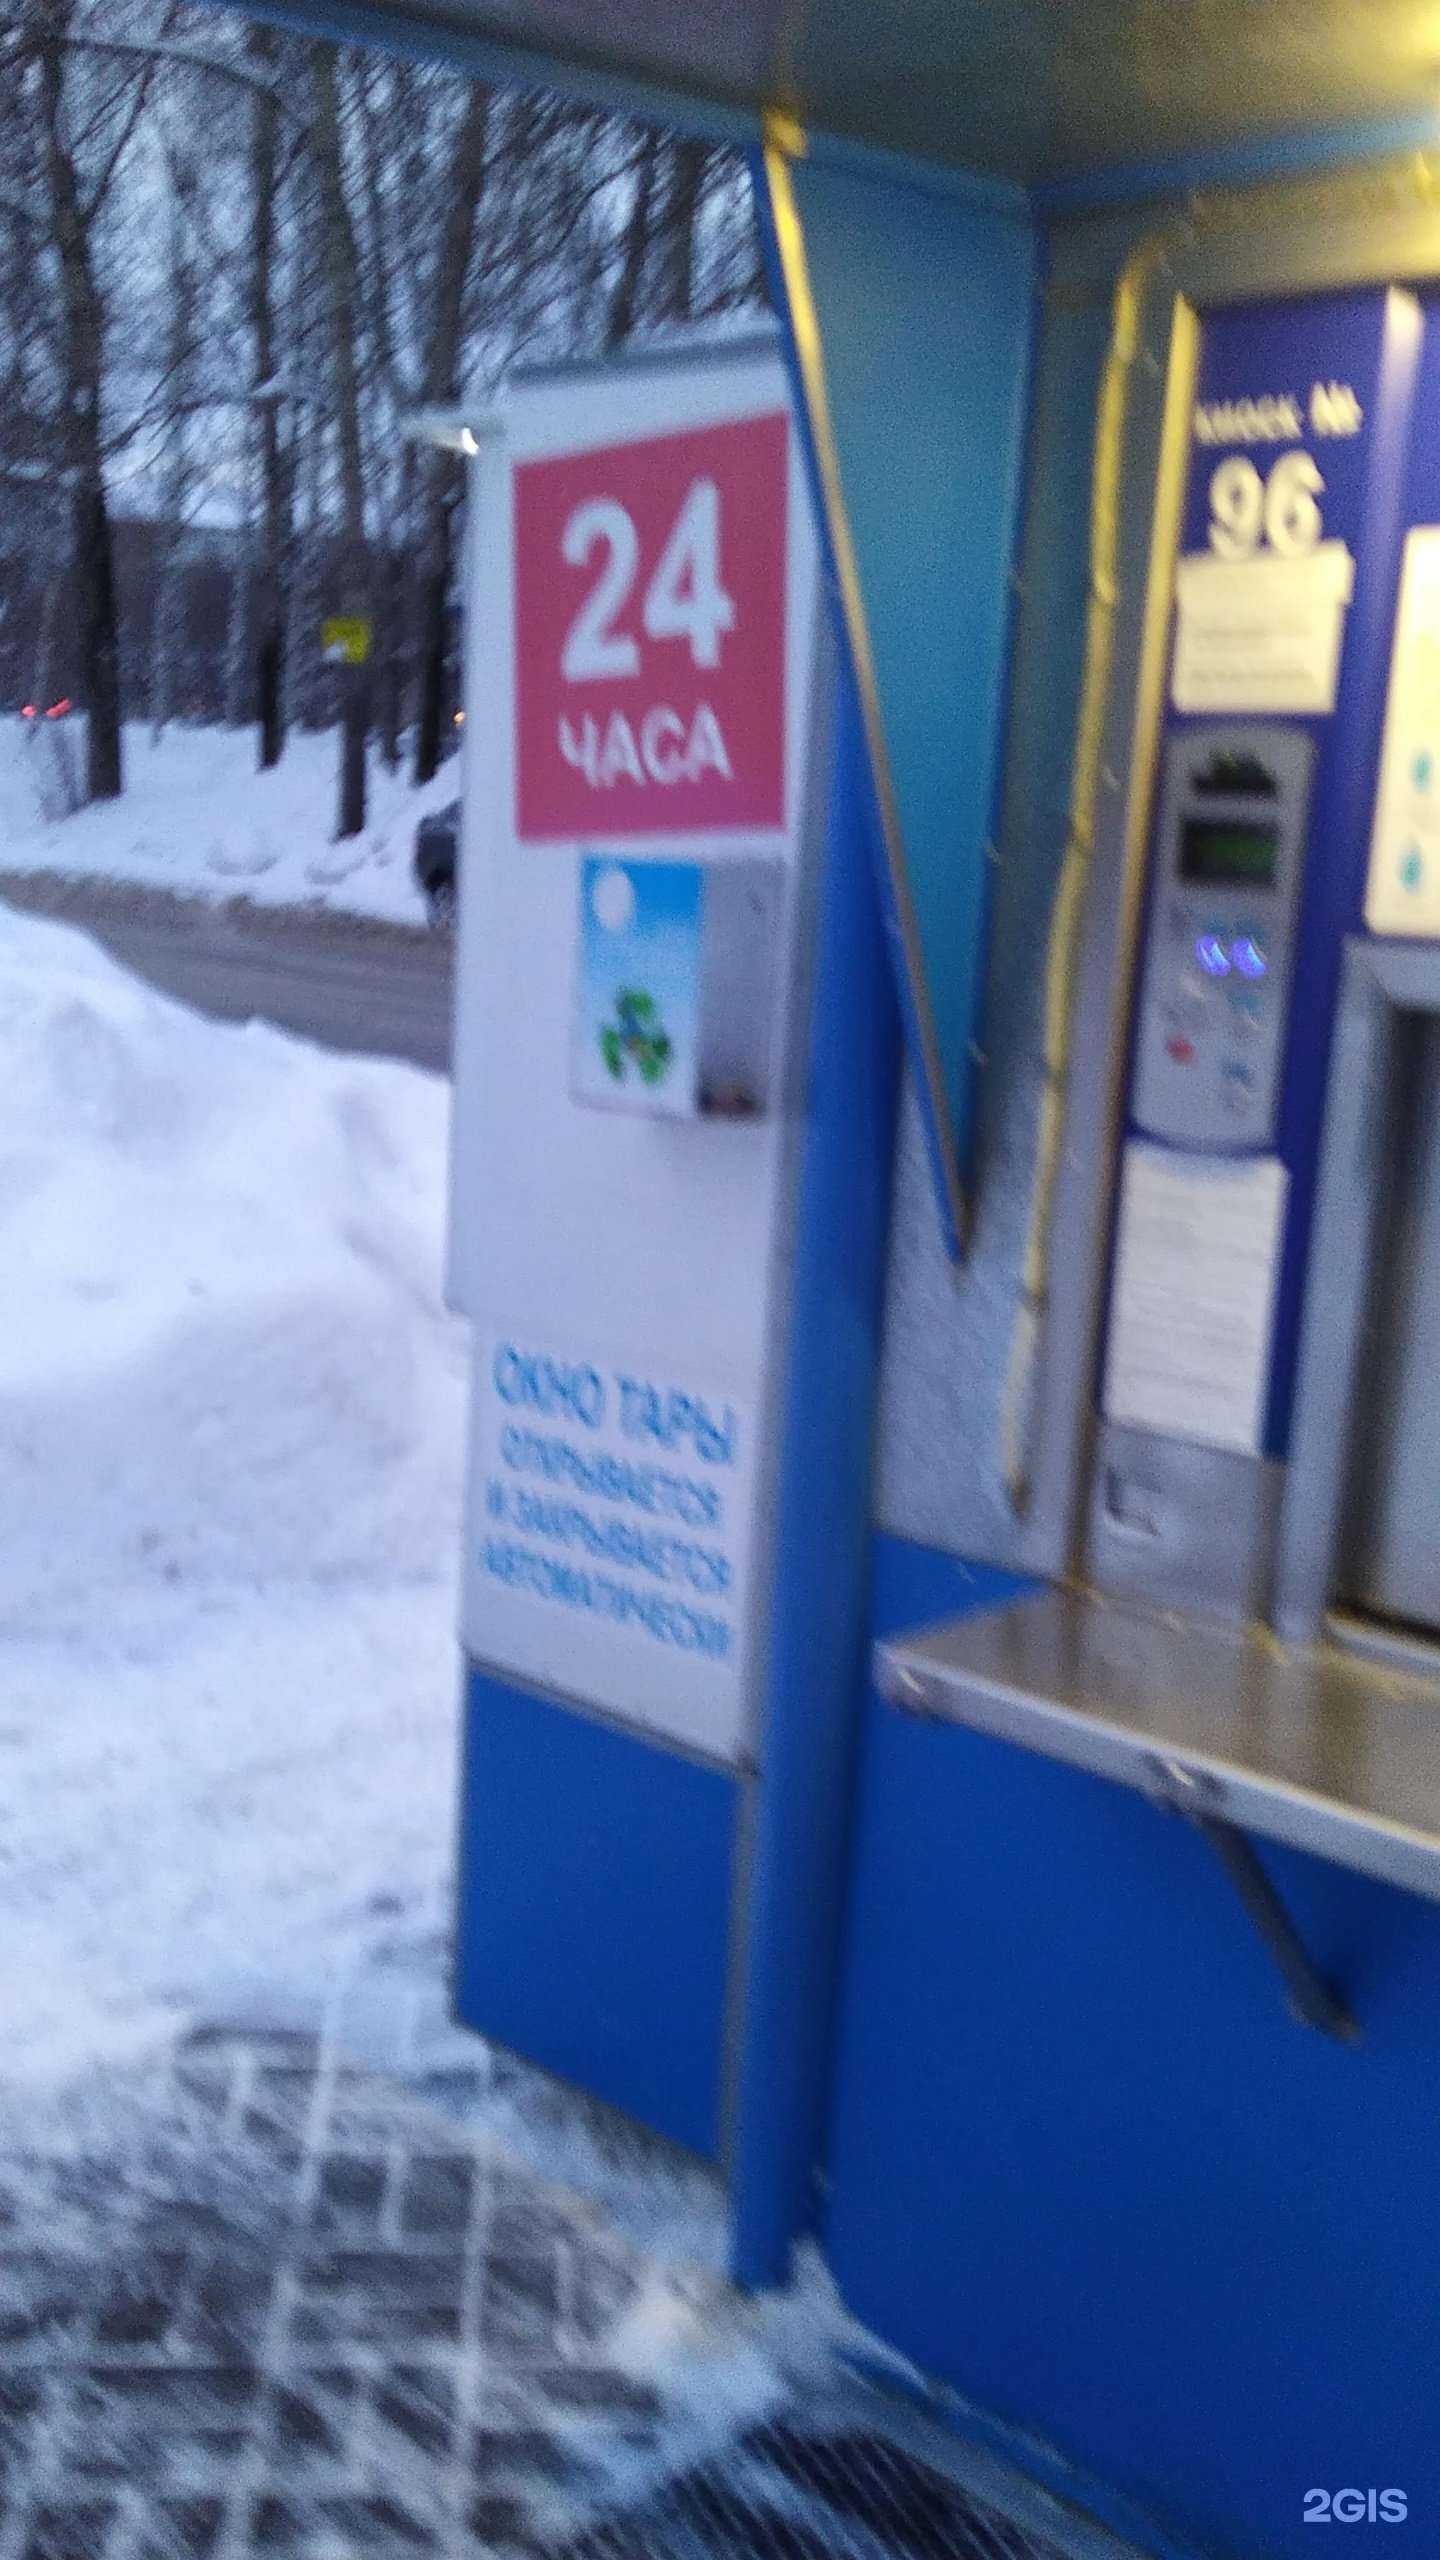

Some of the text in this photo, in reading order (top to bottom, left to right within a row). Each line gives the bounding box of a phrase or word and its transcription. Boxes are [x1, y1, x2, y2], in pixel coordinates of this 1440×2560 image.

[1209, 452, 1325, 561] 96
[560, 473, 737, 683] 24
[558, 703, 736, 788] ЧАСА
[493, 1342, 737, 1464] ОКНО ТАРЫ
[502, 1424, 721, 1528] ОТКРЫВАЕТСЯ
[513, 1488, 731, 1593] ЗАКРЫВАЕТСЯ
[482, 1539, 731, 1656] АВТОМАТИЧЕСКИ
